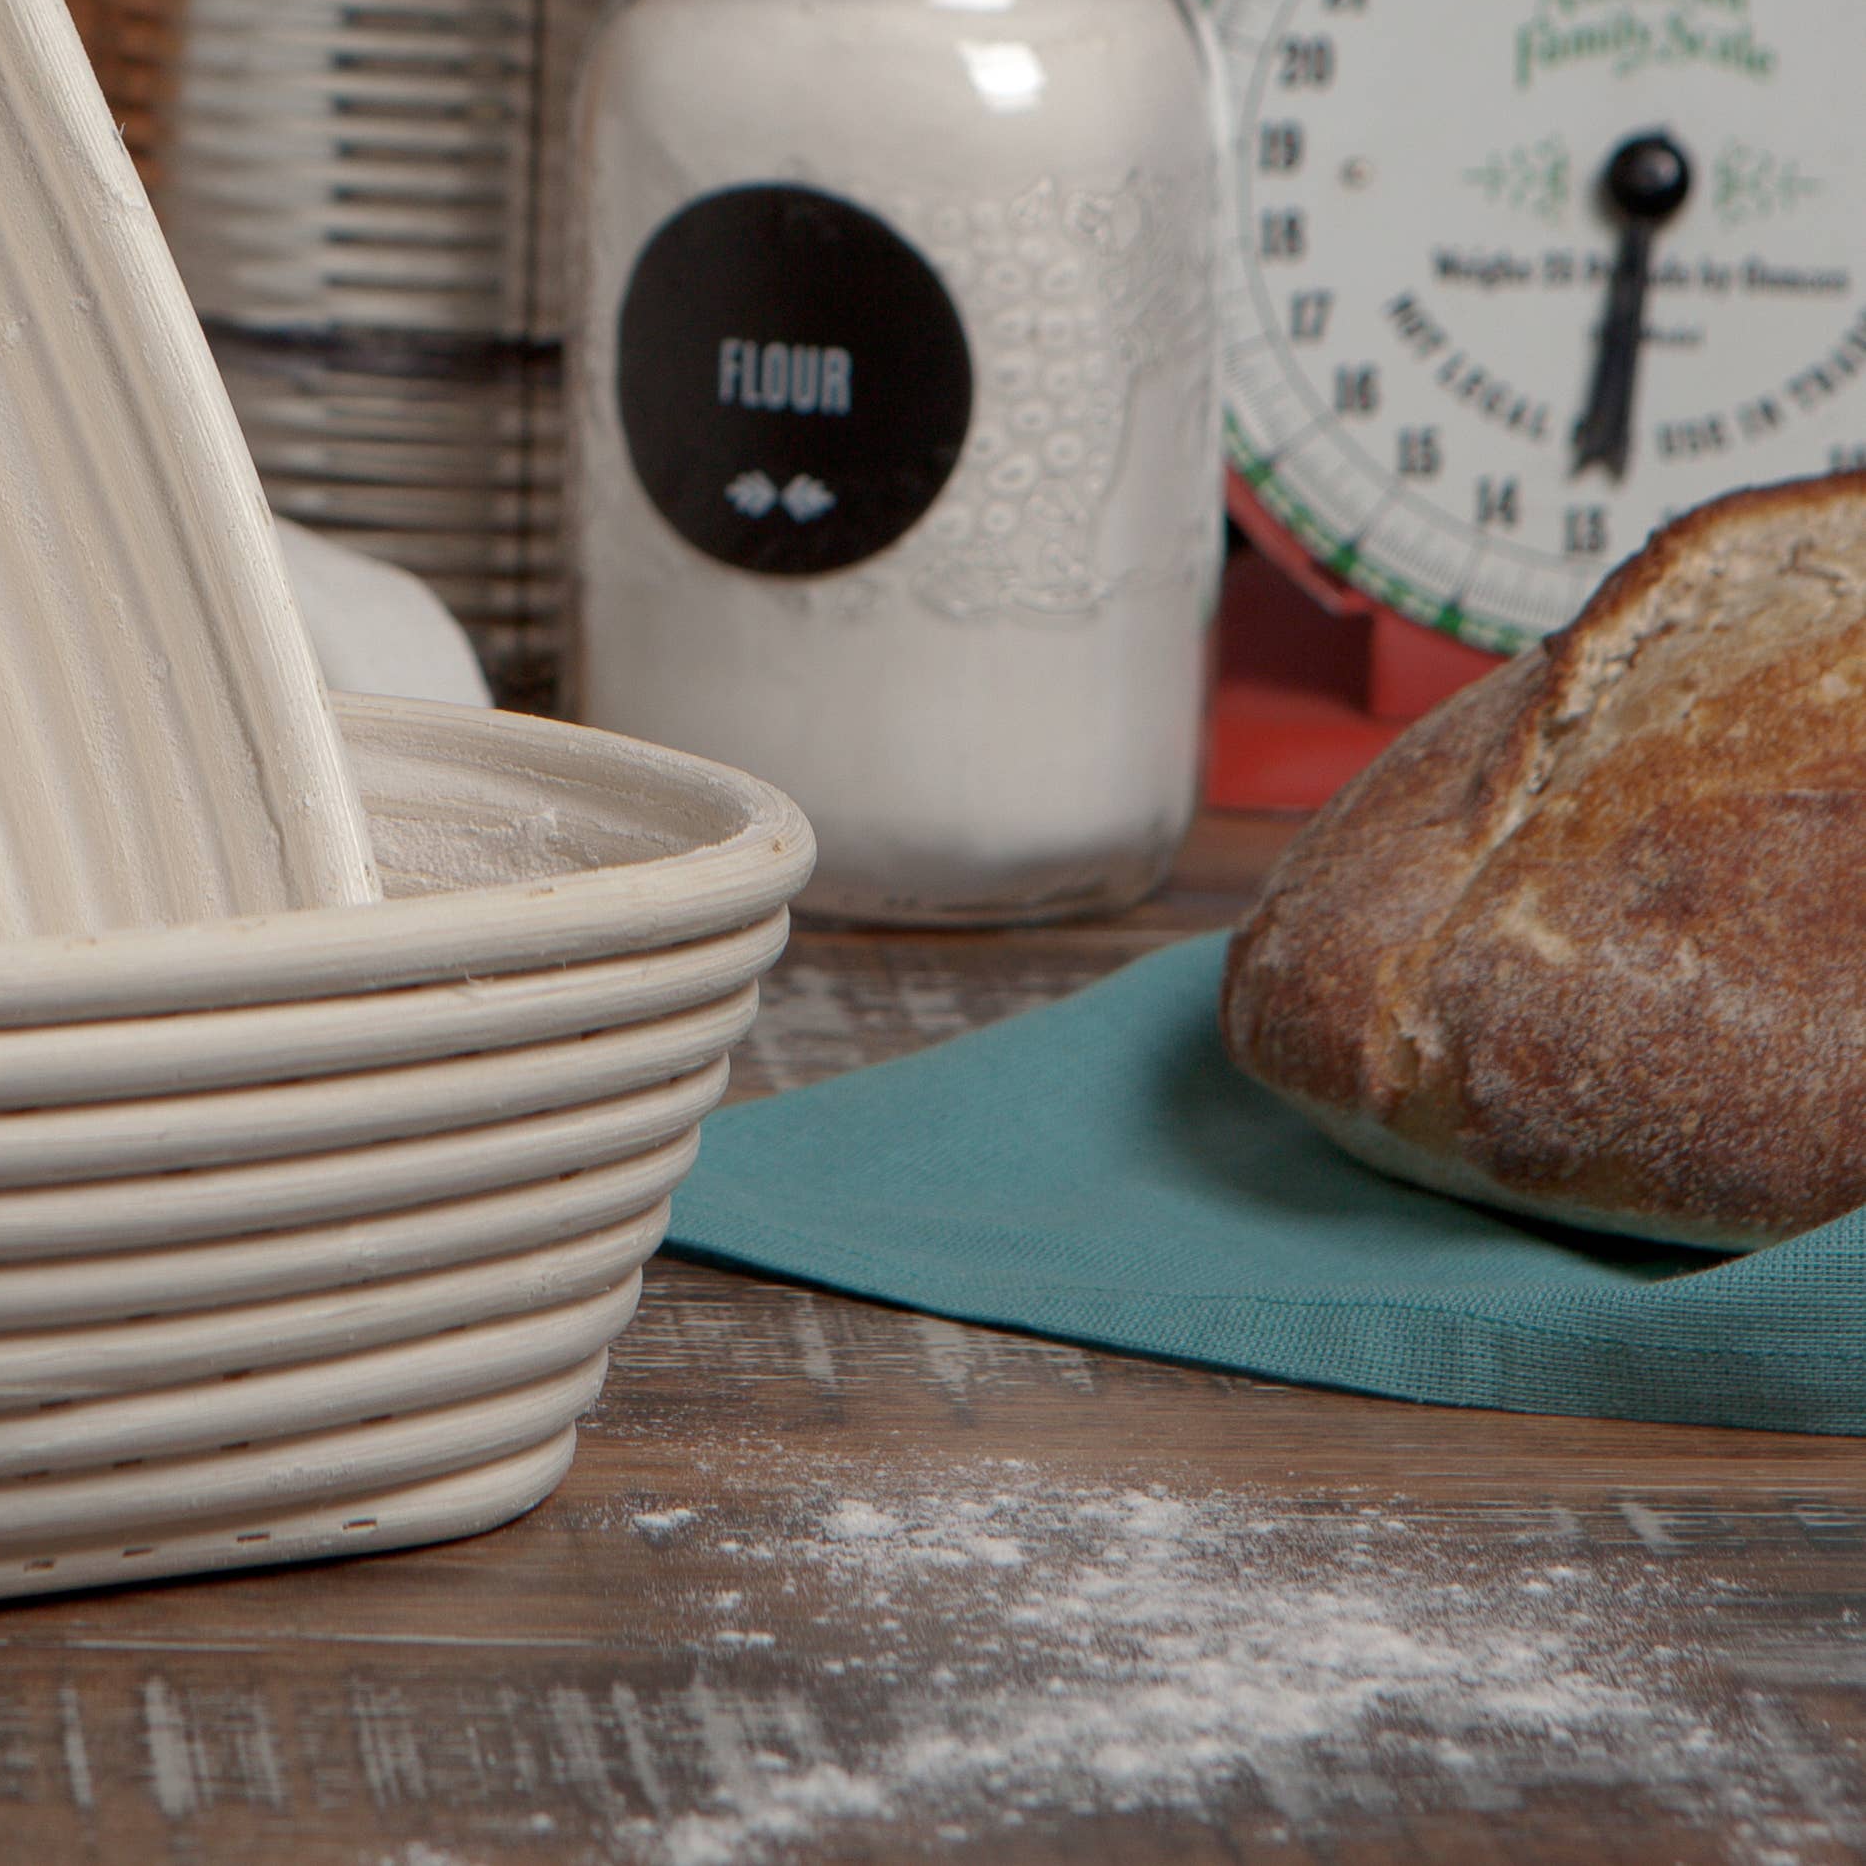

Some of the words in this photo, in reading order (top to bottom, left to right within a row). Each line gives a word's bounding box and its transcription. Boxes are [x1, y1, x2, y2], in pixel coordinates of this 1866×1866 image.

[1277, 36, 1336, 90] 20
[1514, 9, 1652, 88] Family
[1656, 9, 1776, 80] Scale
[1258, 121, 1305, 175] 19
[1260, 209, 1305, 261] 18
[1289, 290, 1334, 340] 17
[717, 337, 853, 415] FLOUR
[1334, 364, 1381, 417] 16
[1437, 351, 1549, 442] LEGAL
[1656, 413, 1728, 461] USE
[1396, 427, 1443, 482] 15
[1475, 478, 1520, 532] 14
[1563, 505, 1609, 564] 13
